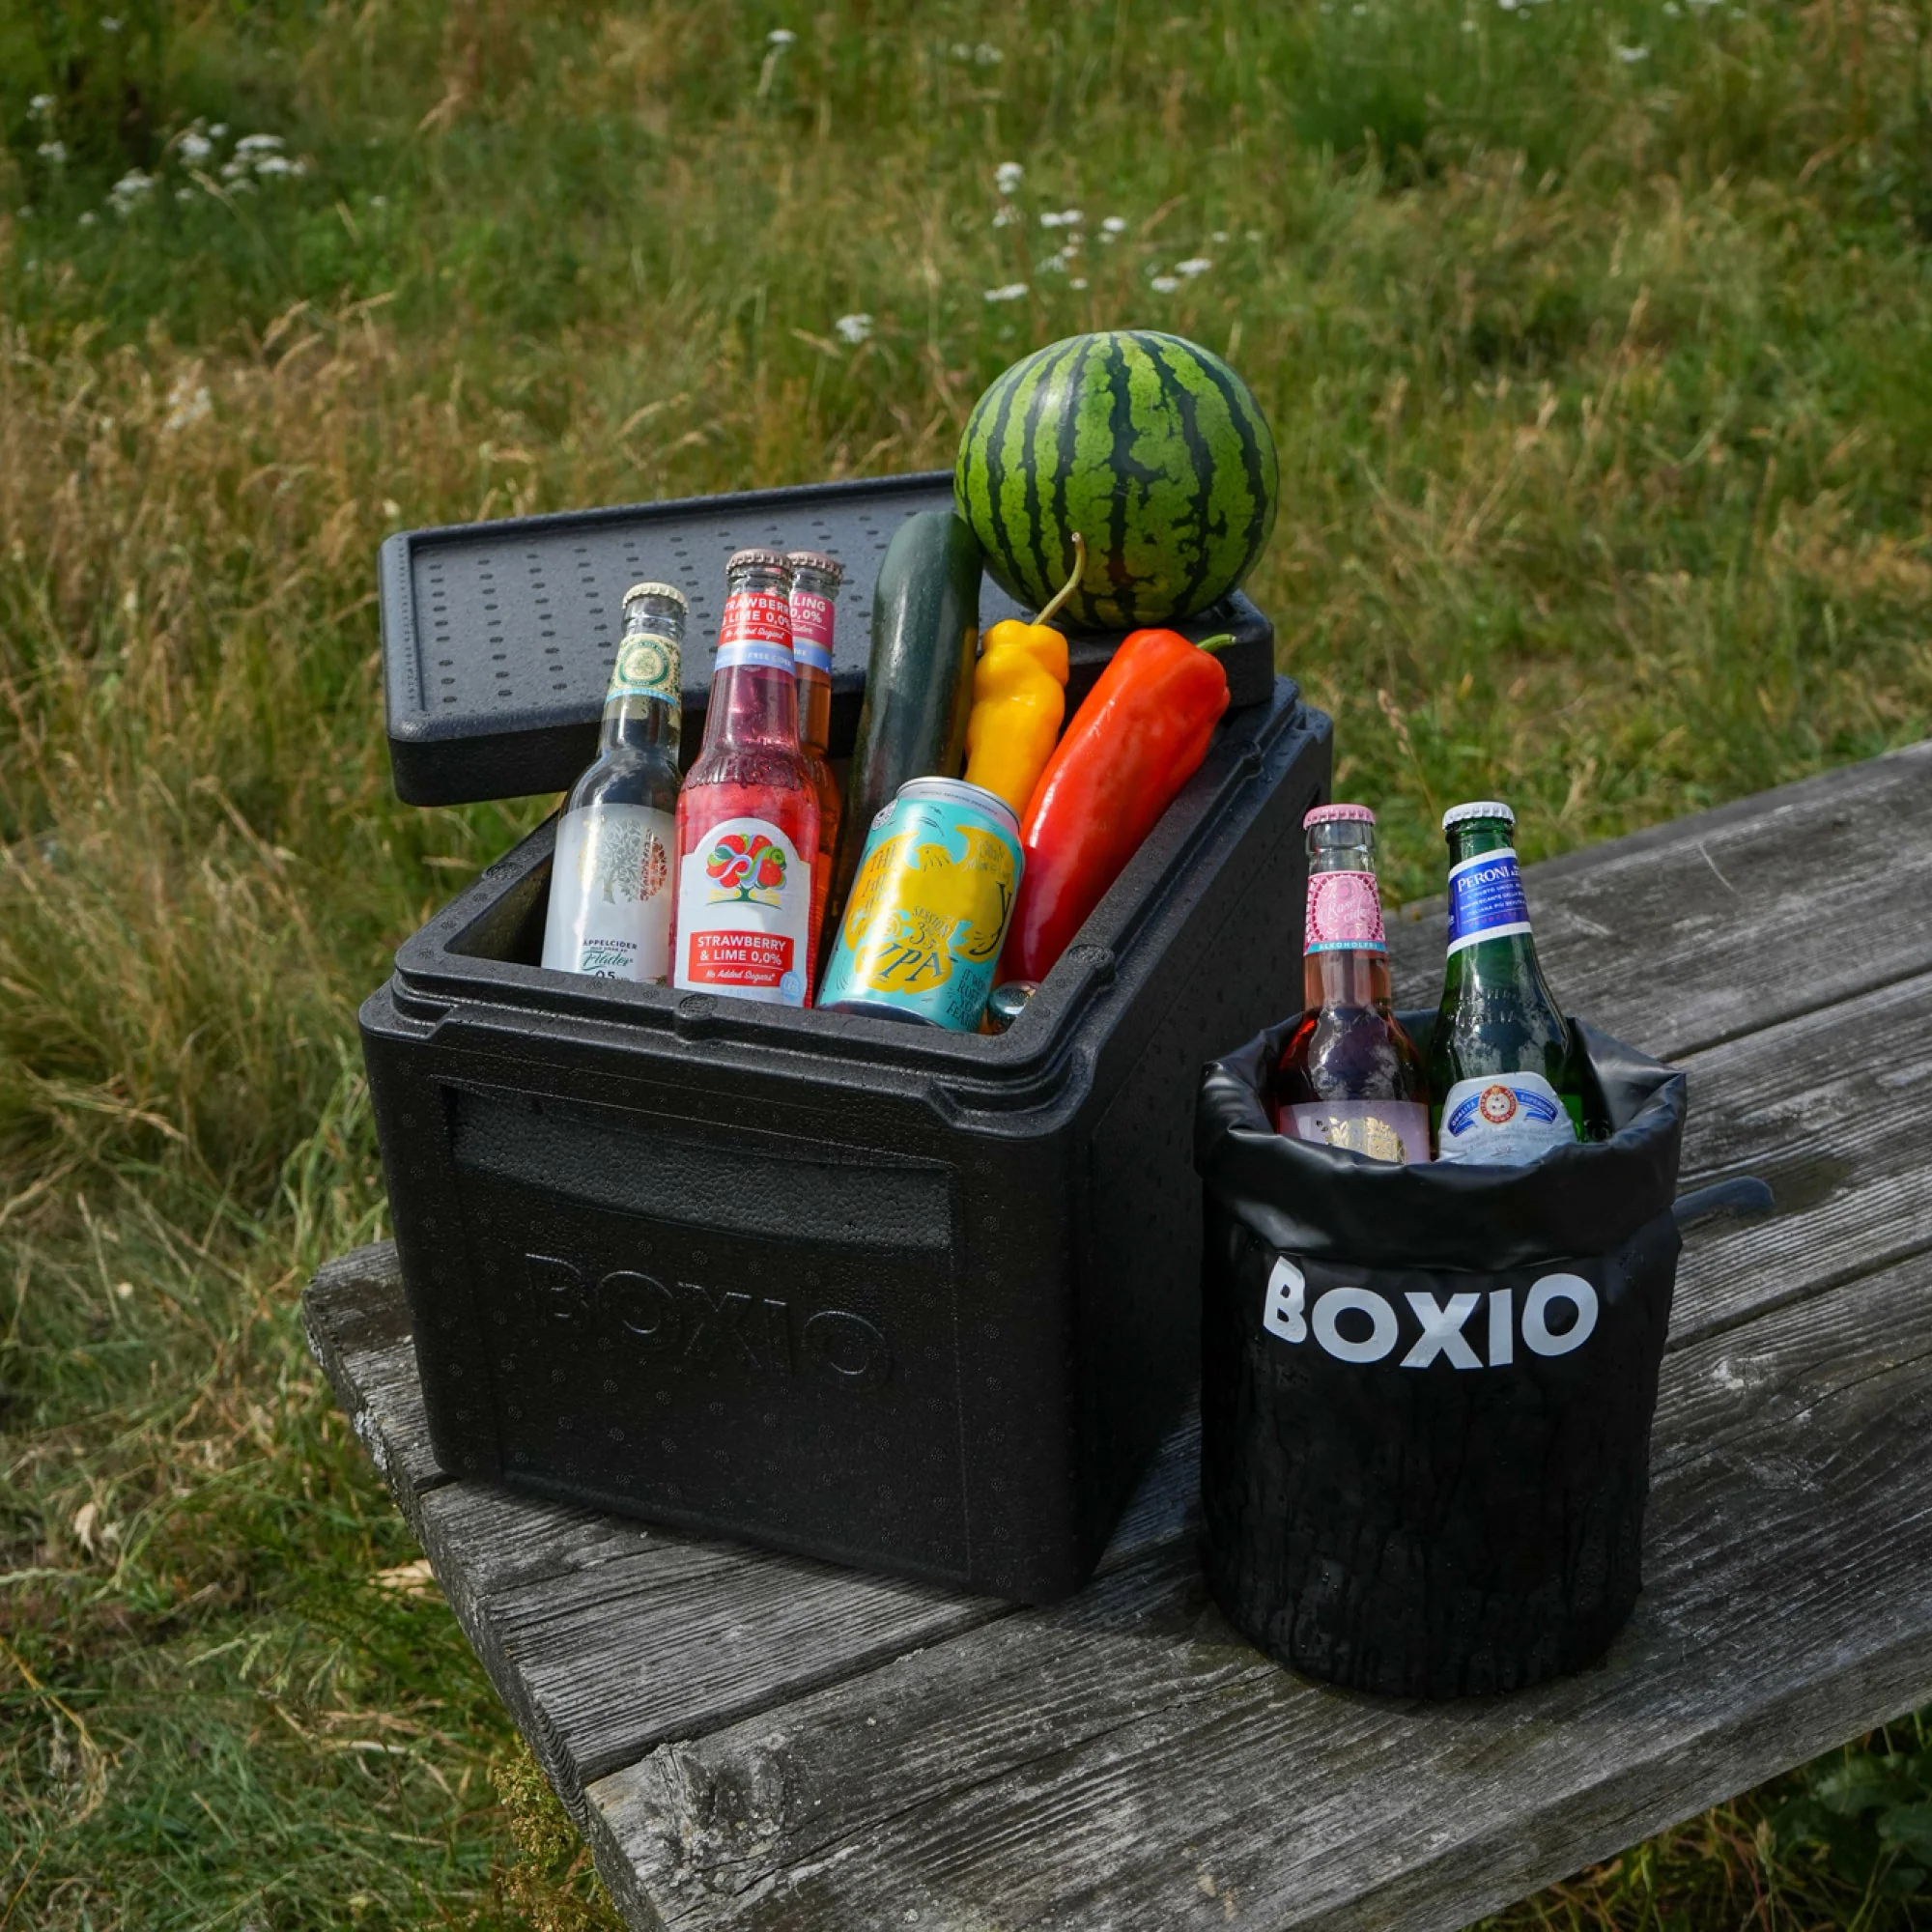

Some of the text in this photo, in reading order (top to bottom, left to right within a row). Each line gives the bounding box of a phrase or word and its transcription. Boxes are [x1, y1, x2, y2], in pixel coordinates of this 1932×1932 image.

[725, 597, 790, 614] TRAWBERR
[728, 610, 761, 623] LIME
[1458, 865, 1510, 893] PERONI
[697, 934, 786, 952] STRAWBERRY
[699, 949, 782, 965] & LIME 0,0%
[718, 969, 744, 979] Added
[525, 1252, 895, 1389] BOXIO
[1263, 1256, 1599, 1370] BOXIO
